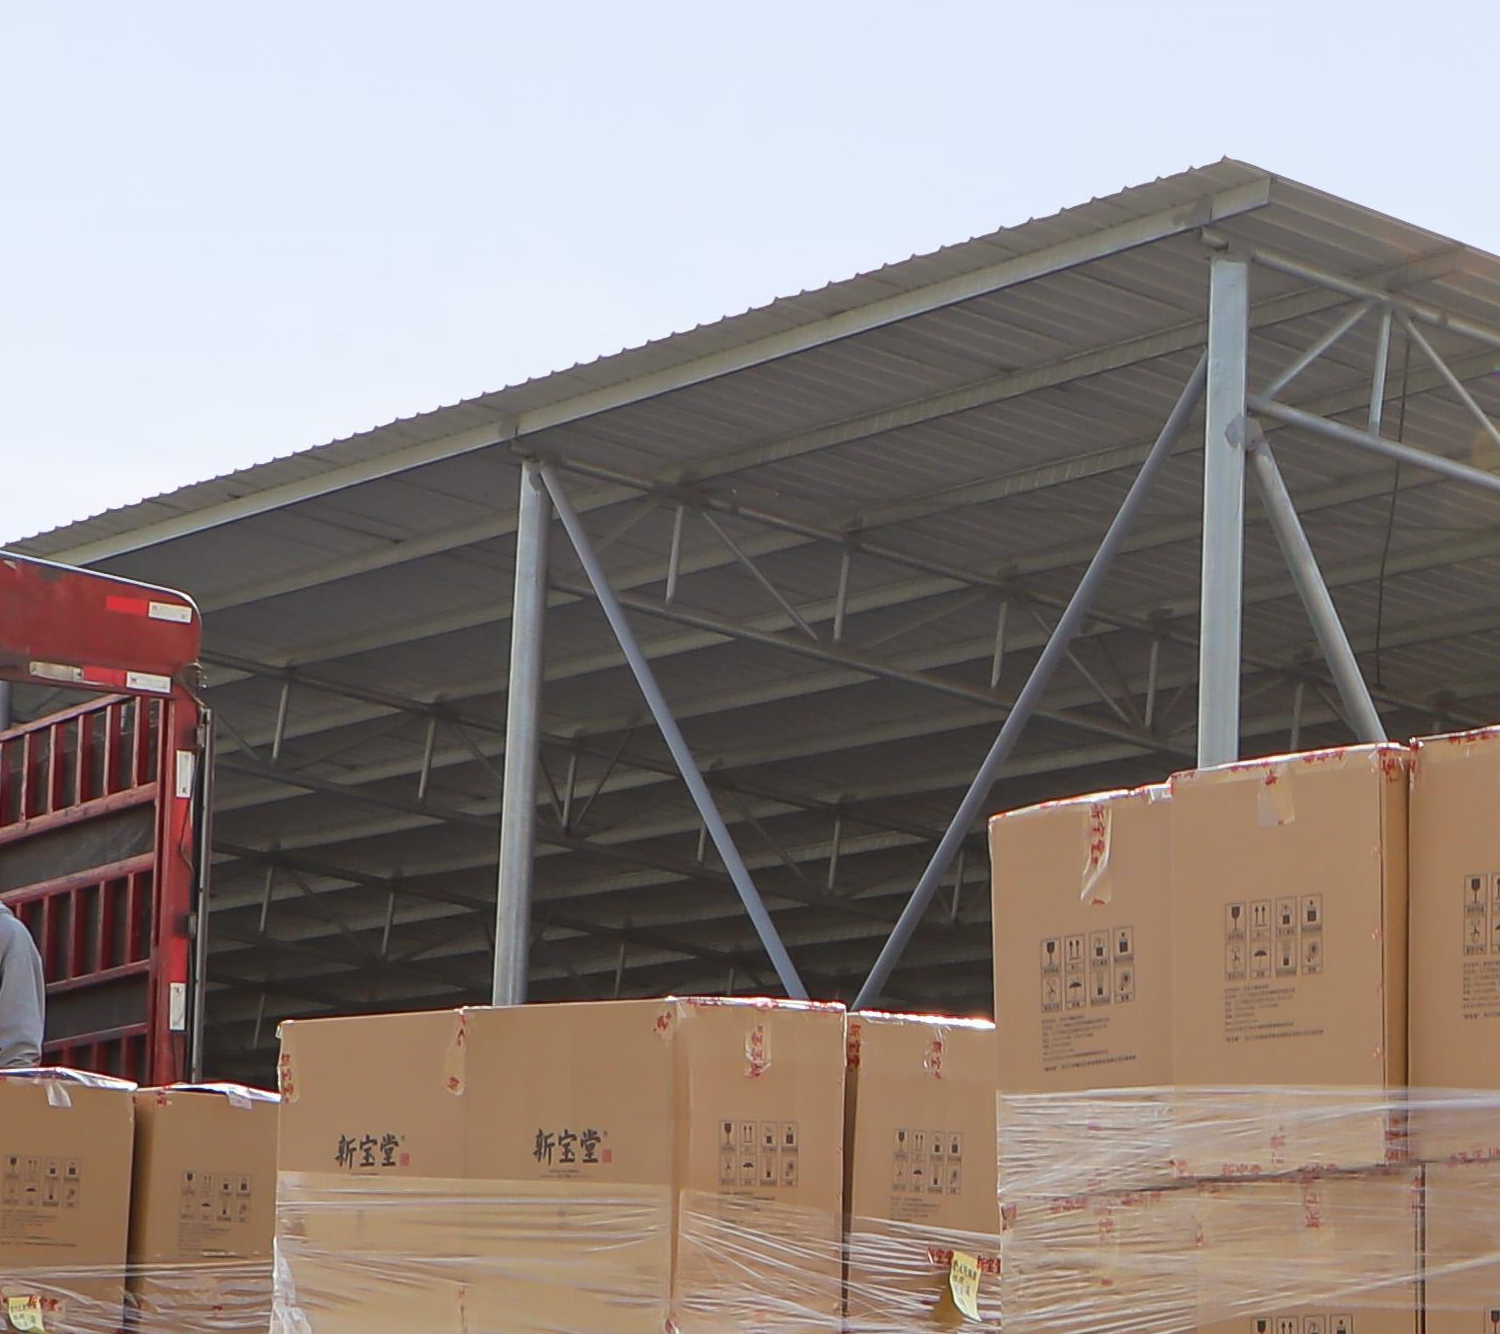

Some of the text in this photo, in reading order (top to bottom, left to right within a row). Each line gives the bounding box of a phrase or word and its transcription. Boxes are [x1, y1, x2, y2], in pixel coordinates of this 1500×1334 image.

[335, 1134, 401, 1169] 新宝堂
[533, 1128, 601, 1164] 新宝堂
